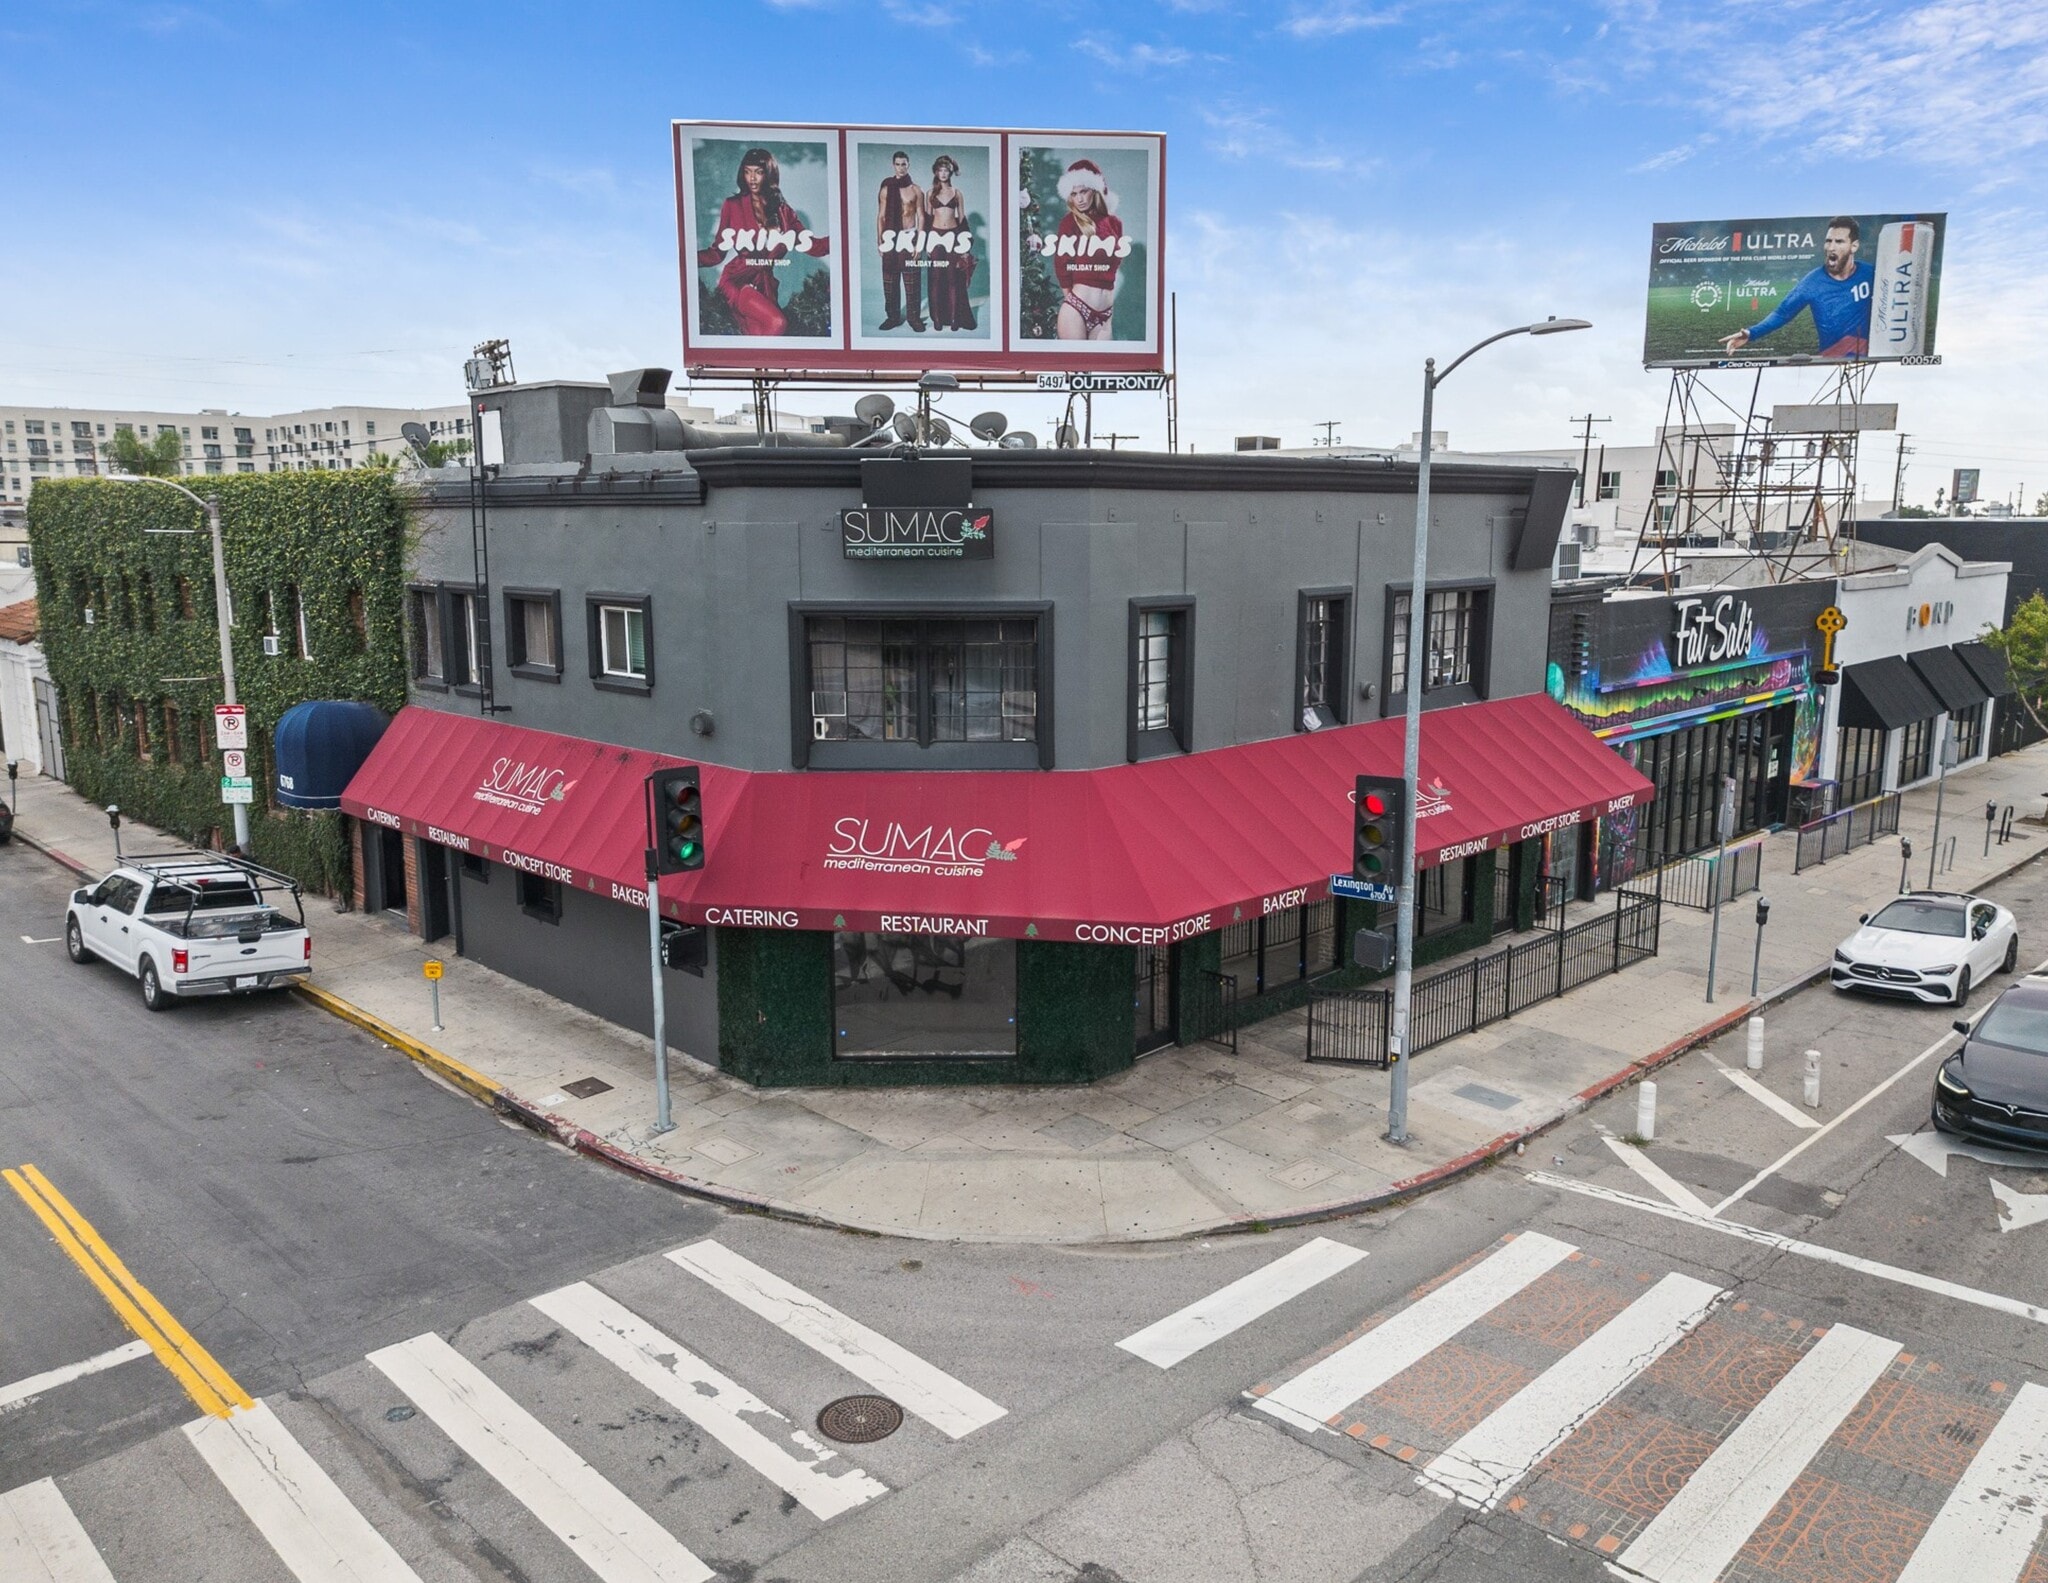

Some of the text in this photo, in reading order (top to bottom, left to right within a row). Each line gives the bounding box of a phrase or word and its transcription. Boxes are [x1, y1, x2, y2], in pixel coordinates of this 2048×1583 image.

[718, 228, 814, 252] SKIMS
[879, 230, 973, 254] SKIMS
[1040, 234, 1133, 258] SKIMS
[1659, 233, 1815, 254] Michelob ULTRA
[745, 258, 791, 266] HOLIDAY SHOP
[905, 260, 932, 268] HOLIDAY
[1736, 287, 1777, 297] ULTRA
[1851, 282, 1869, 302] 10
[1889, 261, 1912, 342] ULTRA
[1901, 357, 1941, 365] 000573
[1039, 376, 1064, 389] 5497
[845, 511, 965, 543] SUMAC
[846, 546, 963, 557] mediterranean cuisine
[1677, 595, 1753, 667] Fat Sal's
[483, 757, 564, 801] SUMAC
[472, 791, 542, 816] mediterranean cuisine
[1608, 794, 1635, 813] BAKERY
[367, 807, 400, 829] CATERING
[1521, 810, 1581, 839] CONCEPT STORE
[428, 827, 470, 850] RESTAURANT
[829, 817, 993, 862] SUMAC
[1439, 837, 1489, 862] RESTAURANT
[503, 849, 572, 884] CONCEPT STORE
[823, 857, 984, 877] mediterranean cuisine
[612, 883, 650, 909] BAKERY
[1333, 875, 1394, 894] Lexington Av
[1370, 891, 1386, 900] 6700
[1262, 887, 1308, 914] BAKERY
[705, 907, 799, 928] CATERING
[881, 915, 989, 936] RESTAURANT
[1075, 914, 1212, 945] CONCEPT STORE
